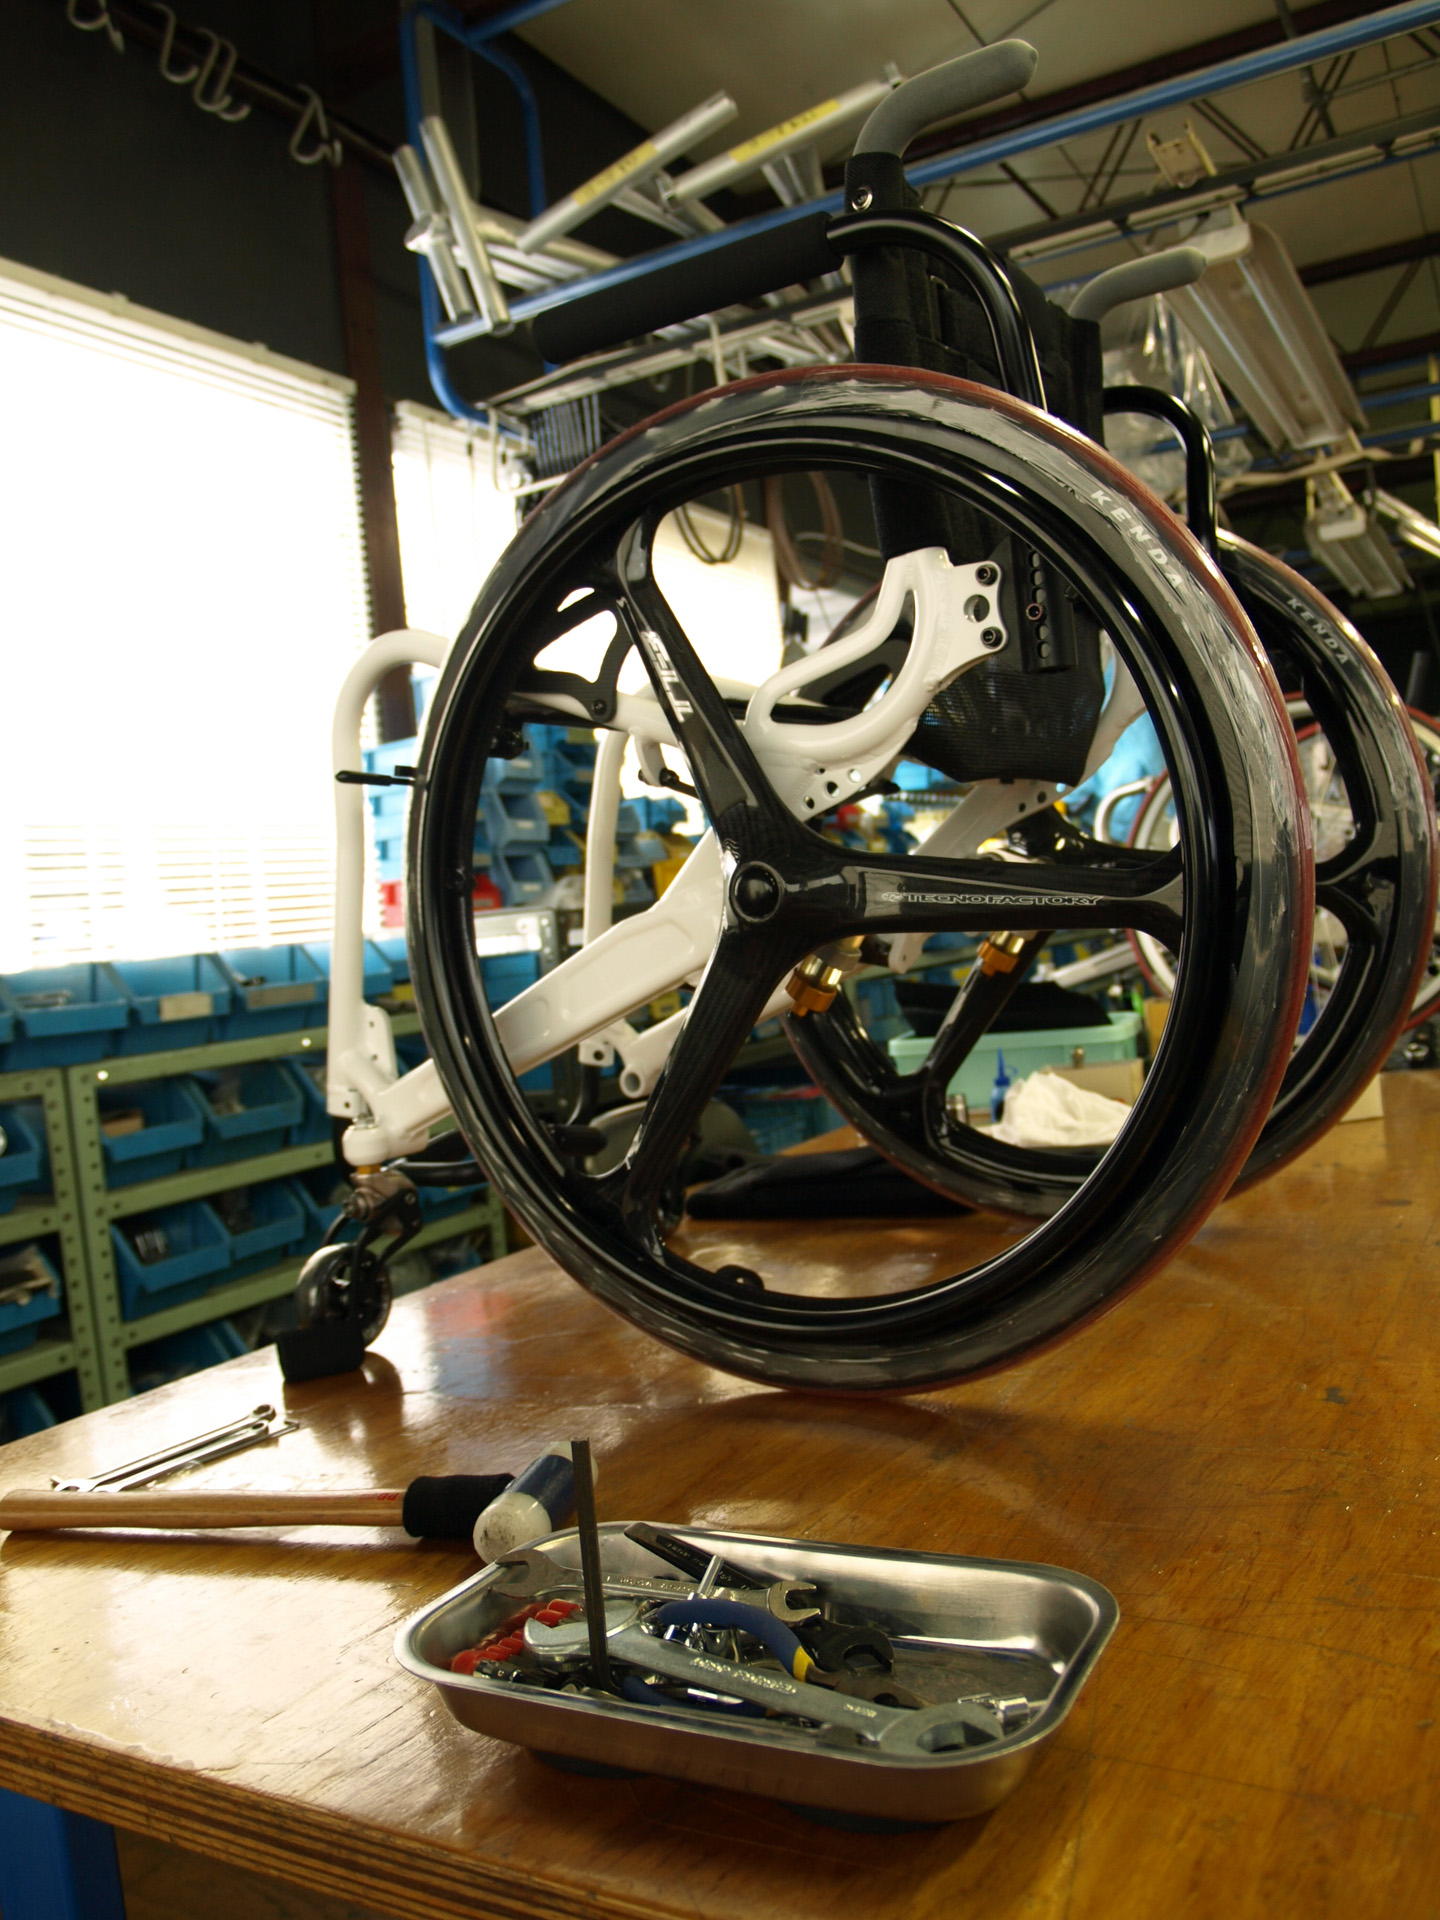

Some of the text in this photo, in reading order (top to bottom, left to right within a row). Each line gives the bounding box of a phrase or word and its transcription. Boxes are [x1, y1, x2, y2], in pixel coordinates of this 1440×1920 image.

[1090, 489, 1183, 588] KENDA
[1287, 598, 1349, 665] KENDA
[902, 892, 1104, 906] TECNOFACTORY
